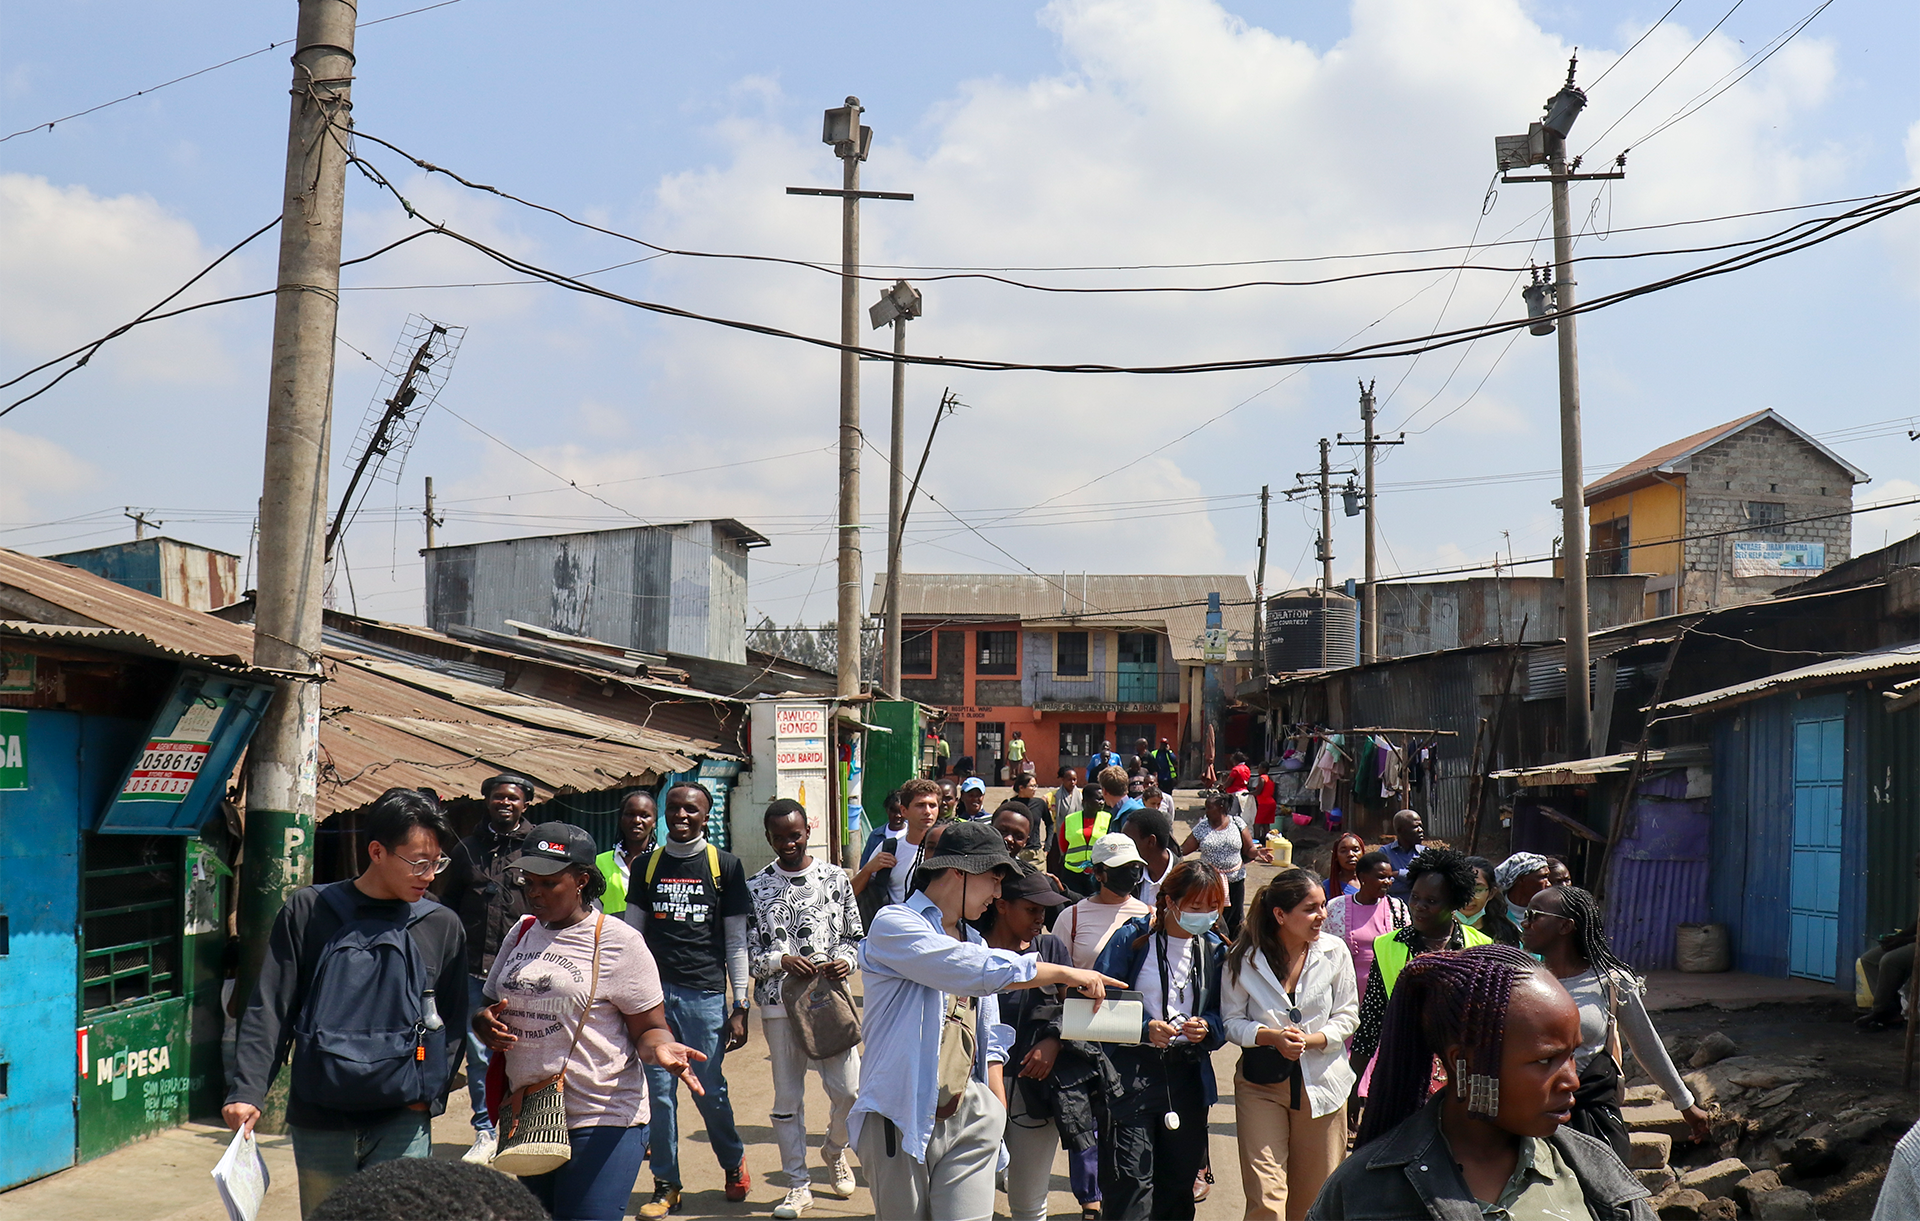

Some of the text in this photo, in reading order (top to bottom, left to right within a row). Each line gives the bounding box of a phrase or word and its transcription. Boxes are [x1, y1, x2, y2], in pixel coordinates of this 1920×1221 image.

[1766, 543, 1784, 551] JIRANI
[1785, 543, 1808, 551] MWEMA
[1735, 551, 1782, 559] SELF HELP GROUP
[779, 722, 818, 734] GONGO
[155, 742, 194, 752] AGENT NUMBER
[777, 752, 823, 764] SODA BARIDI
[147, 770, 164, 778] STORE
[656, 883, 705, 895] SHUJAA
[669, 893, 690, 903] WA
[652, 902, 709, 915] MATHARE
[542, 952, 584, 983] OUTDOORS
[525, 1011, 536, 1020] THE
[536, 1012, 557, 1022] WORLD
[524, 1030, 545, 1039] TRAIL
[544, 1022, 565, 1036] AREA
[144, 1097, 160, 1110] NEW
